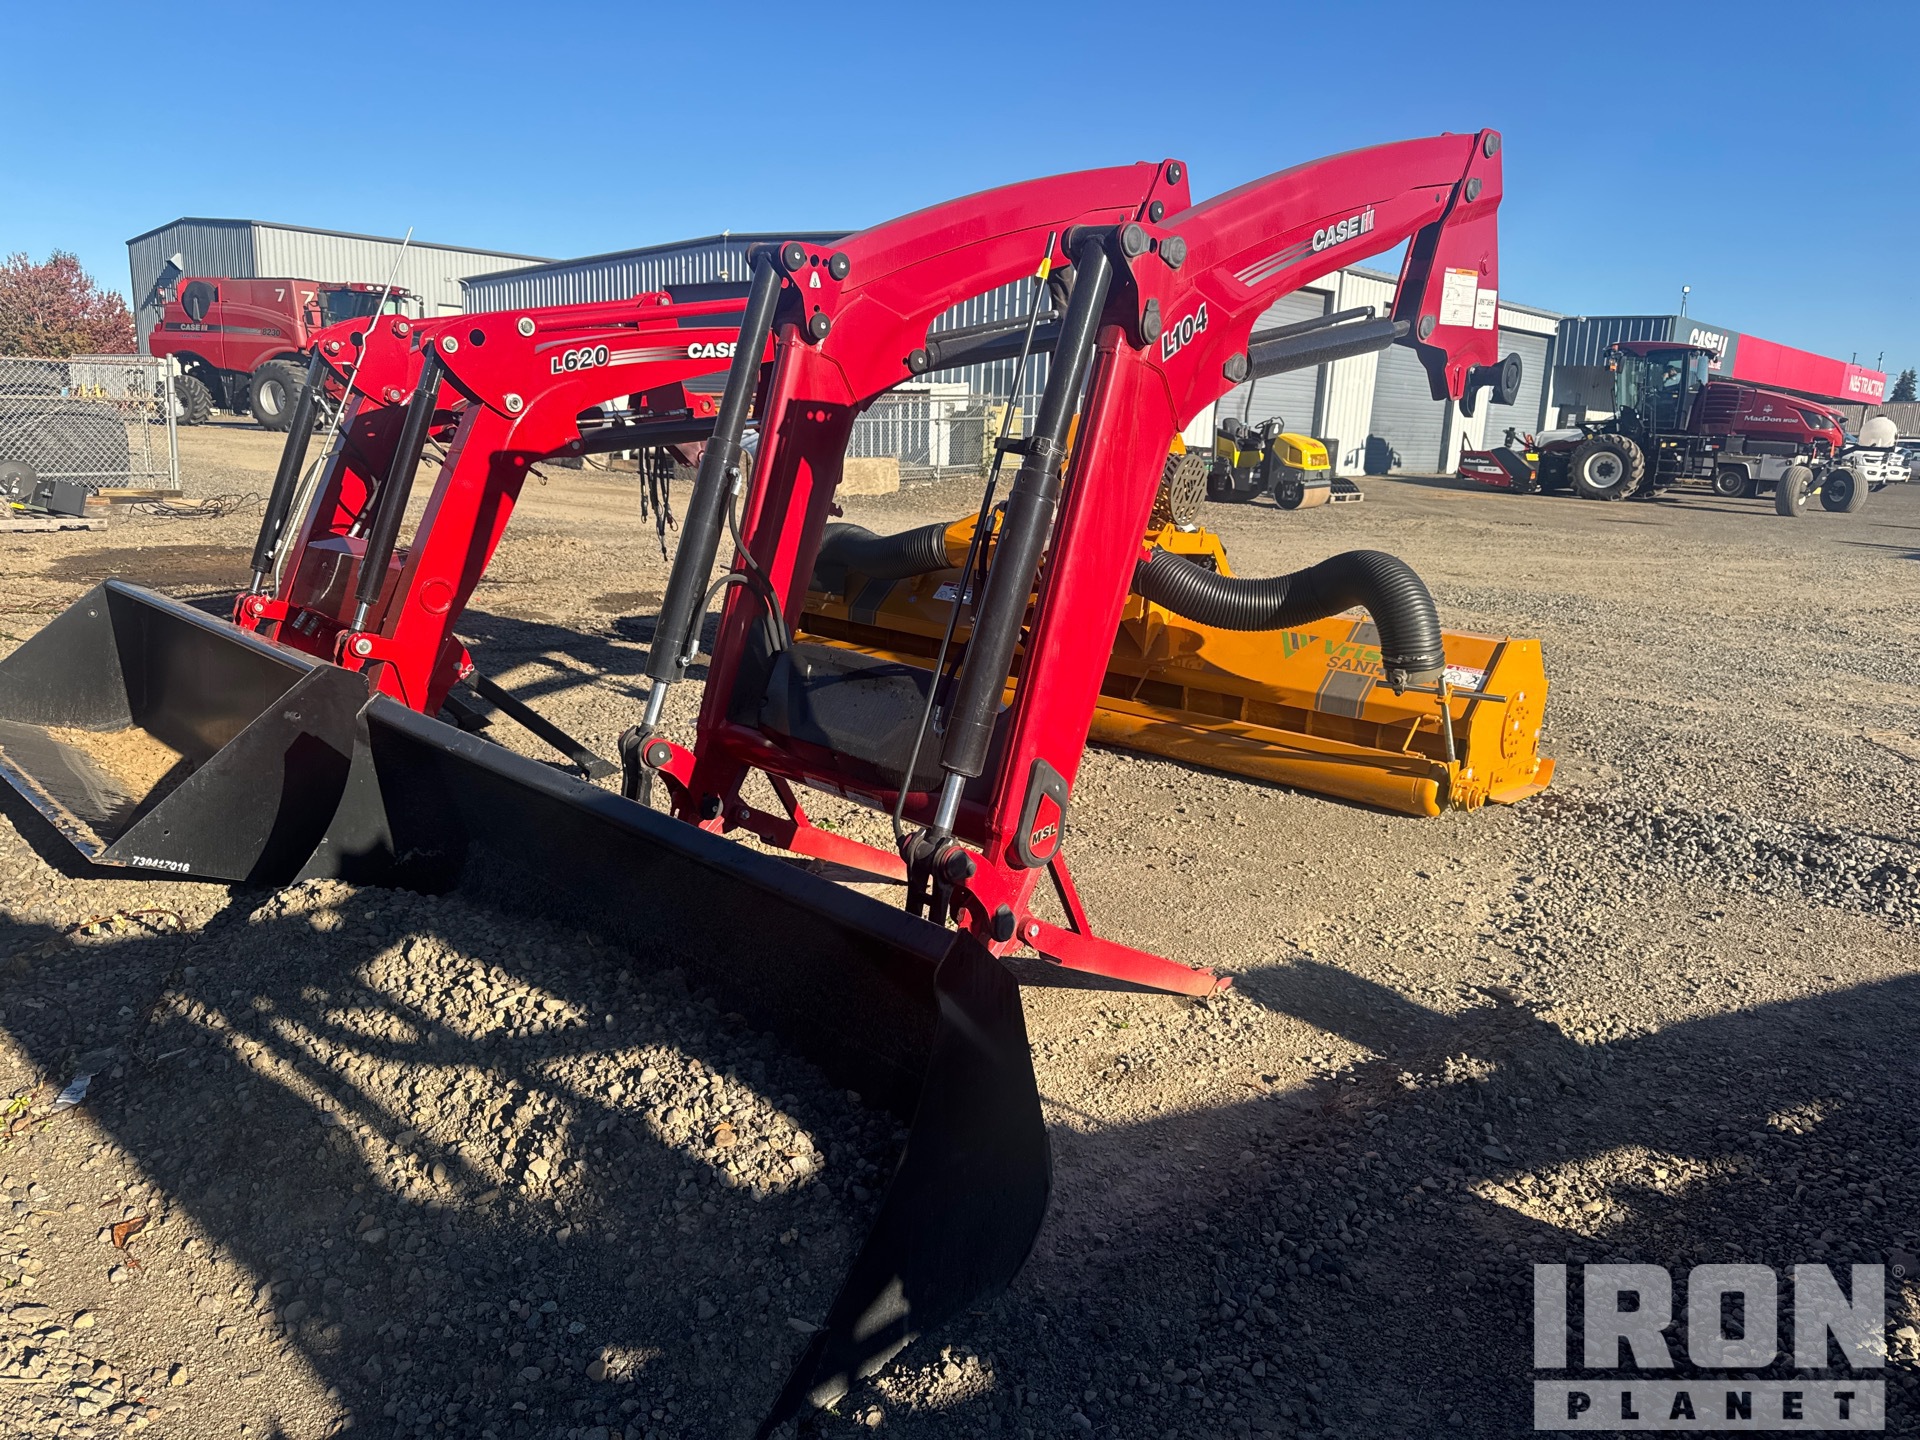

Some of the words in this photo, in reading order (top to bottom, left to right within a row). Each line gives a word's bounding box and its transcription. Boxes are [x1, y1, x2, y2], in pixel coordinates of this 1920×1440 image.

[1313, 216, 1359, 252] CASE
[275, 288, 285, 302] 7
[301, 290, 315, 304] 7
[180, 323, 200, 331] CASE
[262, 328, 280, 337] 8230
[1162, 301, 1208, 363] L104
[1689, 328, 1720, 350] CASE
[551, 345, 609, 375] L620
[1860, 377, 1885, 397] TRACTOR
[1744, 415, 1782, 423] MacDon
[1031, 823, 1057, 846] MSL
